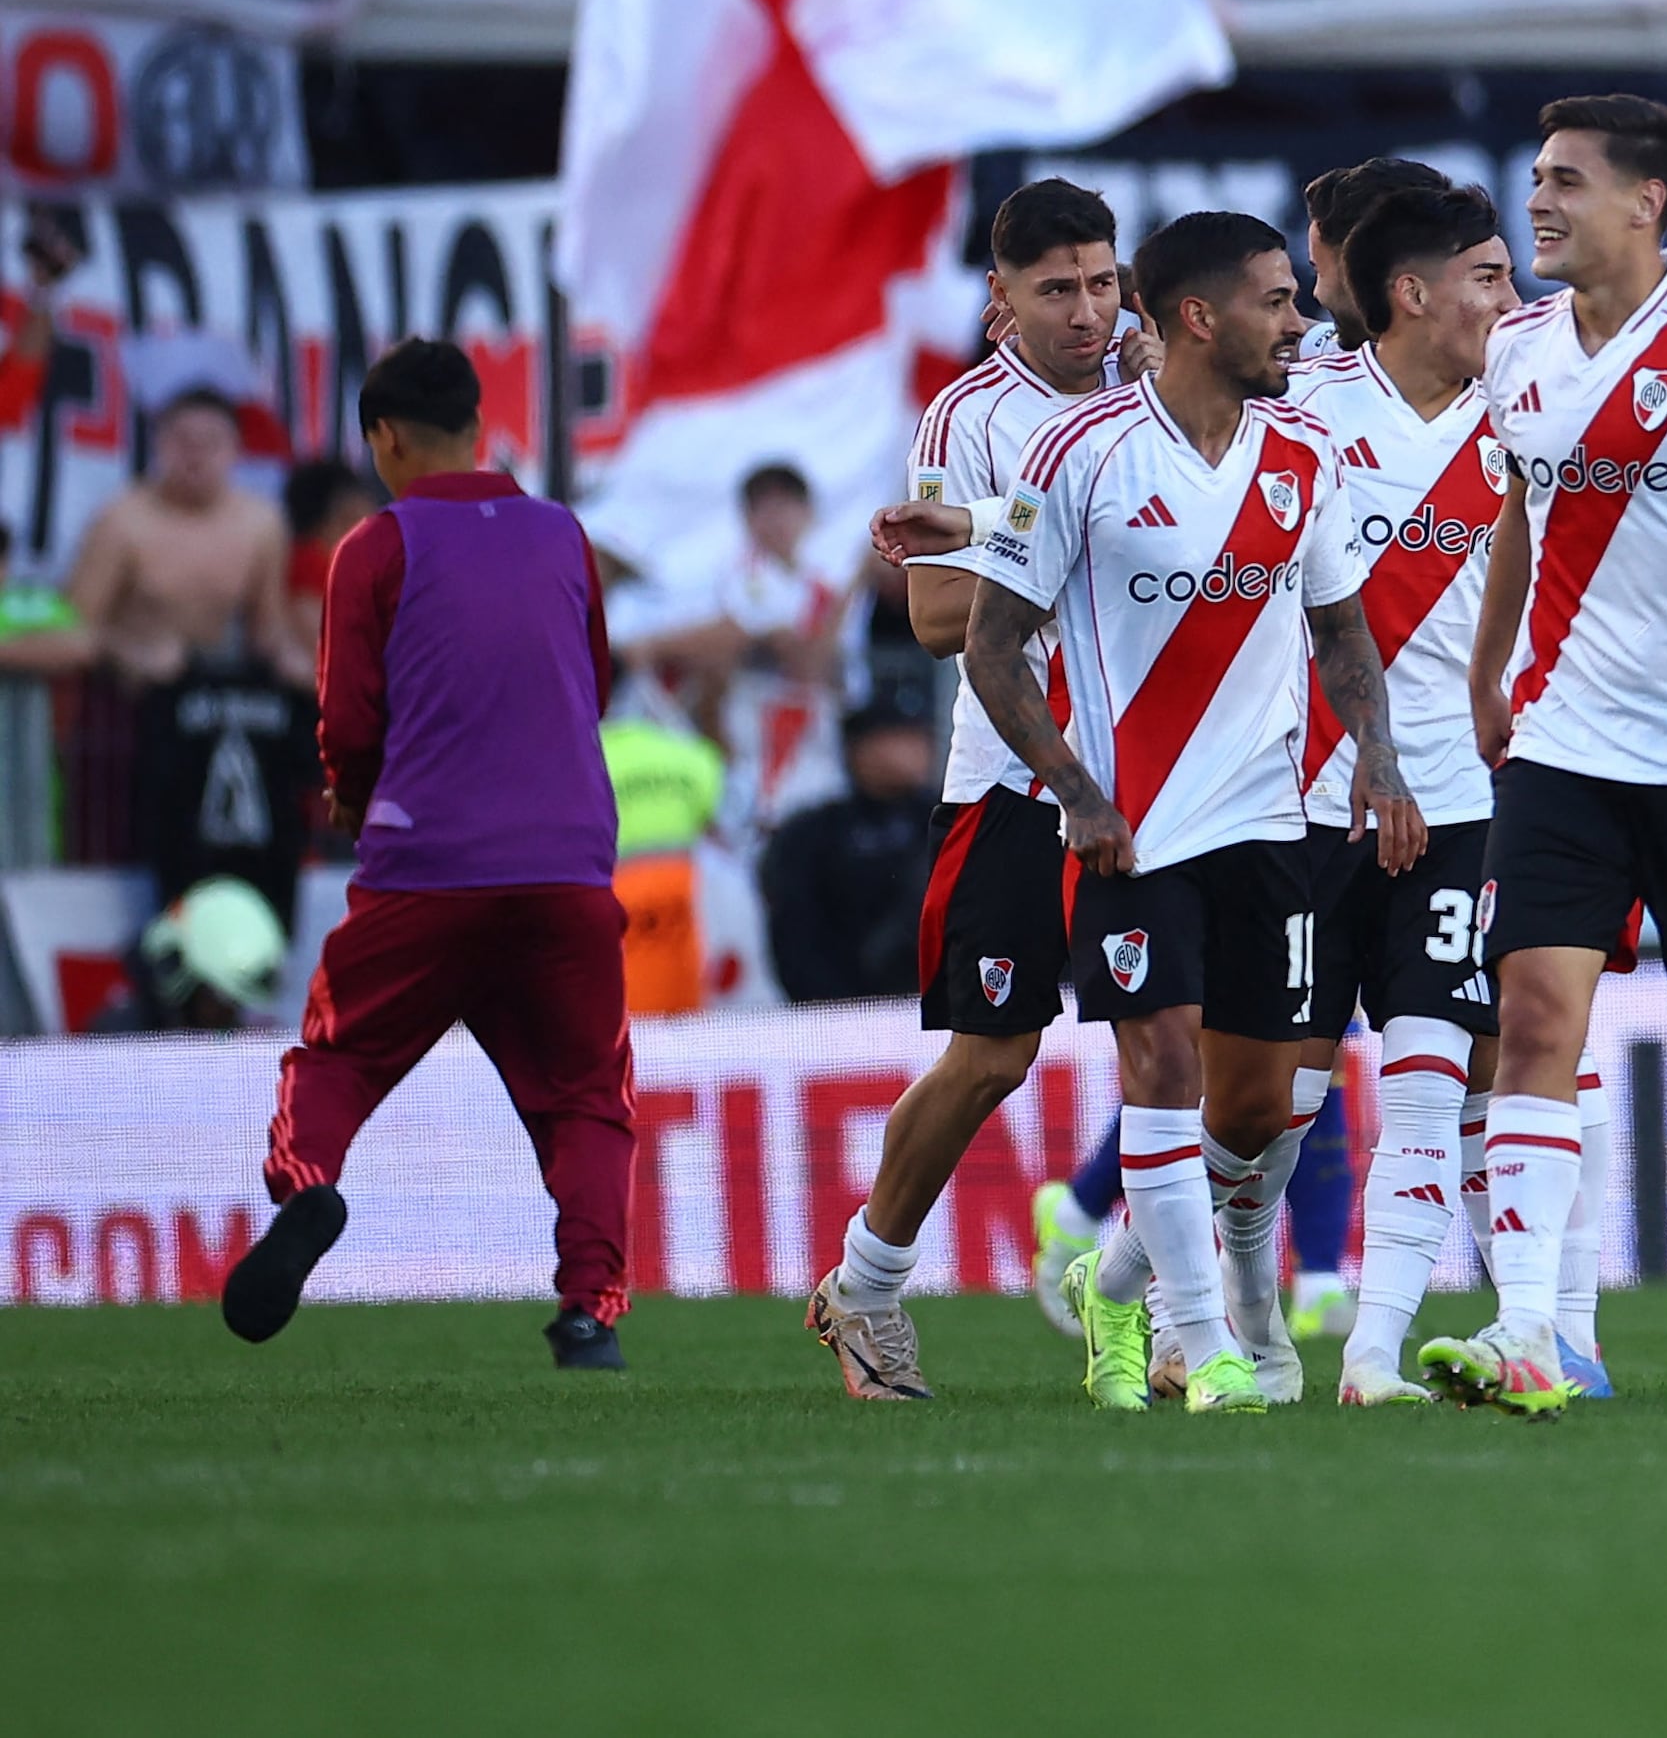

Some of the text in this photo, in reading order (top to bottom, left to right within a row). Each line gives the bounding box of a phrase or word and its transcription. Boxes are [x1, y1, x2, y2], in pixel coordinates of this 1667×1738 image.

[990, 530, 1030, 552] SIST
[1361, 504, 1495, 556] oder
[1127, 552, 1301, 604] codere
[630, 1060, 1076, 1295] TIEN
